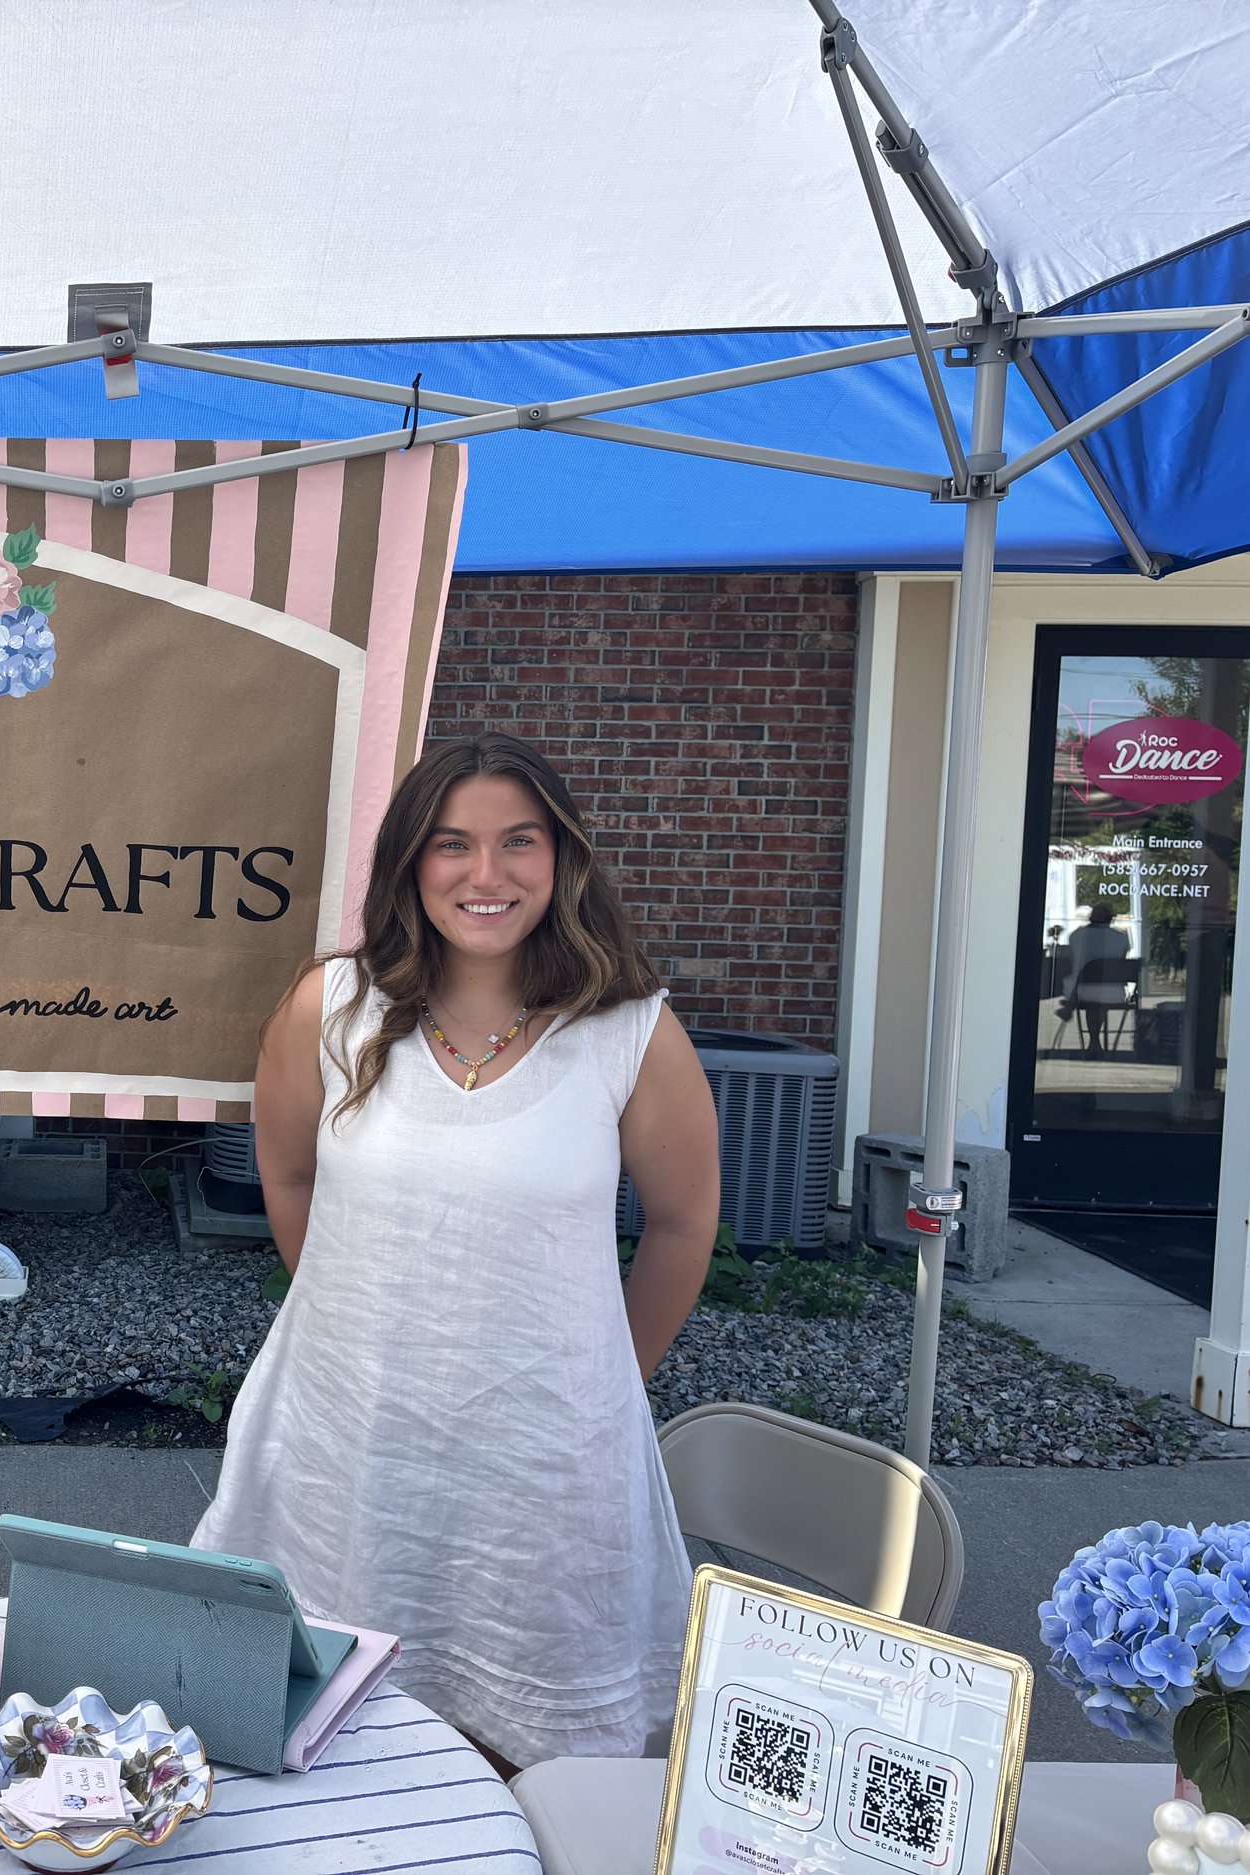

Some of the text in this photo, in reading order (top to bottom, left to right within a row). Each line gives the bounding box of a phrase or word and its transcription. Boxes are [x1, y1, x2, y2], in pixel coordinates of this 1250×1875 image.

[1148, 734, 1178, 747] Roc
[1109, 739, 1223, 774] Dance
[1112, 835, 1203, 849] Main Entrance
[1139, 863, 1209, 877] 667-0957
[114, 997, 178, 1022] art
[739, 1596, 975, 1688] FOLLOW US ON
[740, 1632, 958, 1709] social media
[755, 1702, 796, 1721] SCAN ME
[719, 1720, 729, 1759] SCAN ME
[888, 1748, 930, 1768] SCAN ME
[809, 1779, 818, 1793] ME
[848, 1766, 860, 1808] SCAN ME
[743, 1791, 783, 1811] SCAN ME
[945, 1800, 958, 1843] SCAN ME
[735, 1841, 779, 1865] Instagram
[875, 1840, 918, 1861] SCAN ME
